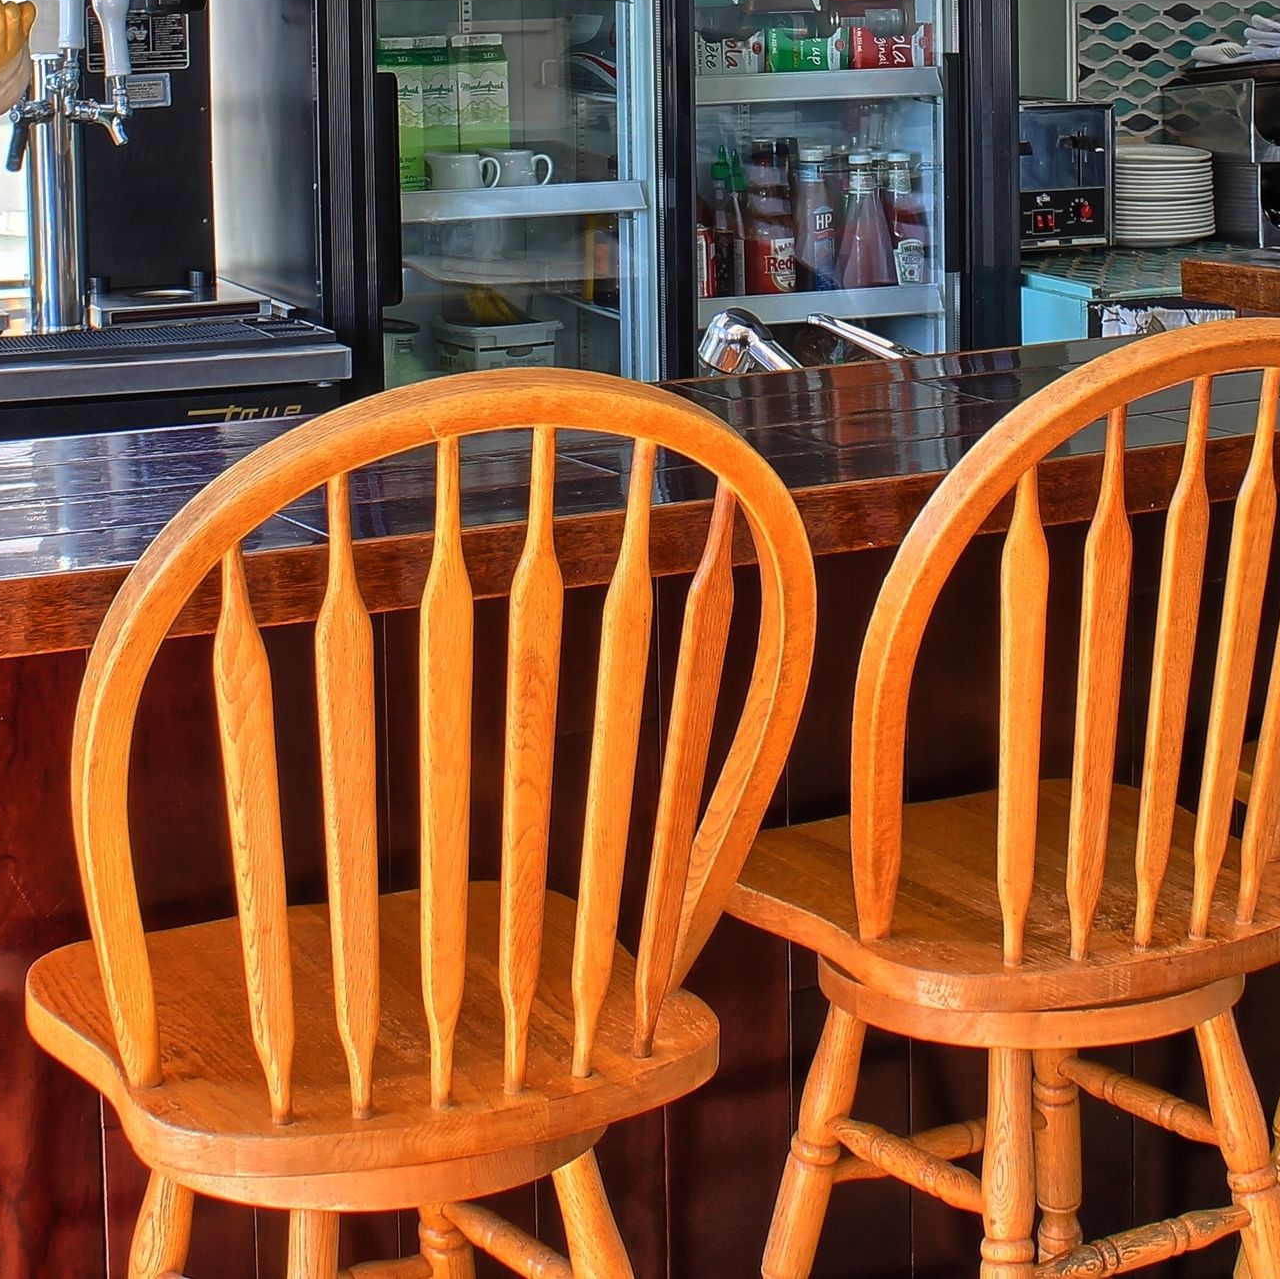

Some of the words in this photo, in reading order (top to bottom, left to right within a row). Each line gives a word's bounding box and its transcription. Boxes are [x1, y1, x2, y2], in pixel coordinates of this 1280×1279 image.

[705, 41, 718, 69] iète
[724, 38, 744, 69] ola
[807, 46, 821, 65] up
[874, 37, 890, 66] ginal
[892, 36, 910, 65] ola
[815, 213, 833, 230] HP
[774, 240, 794, 257] FRAN
